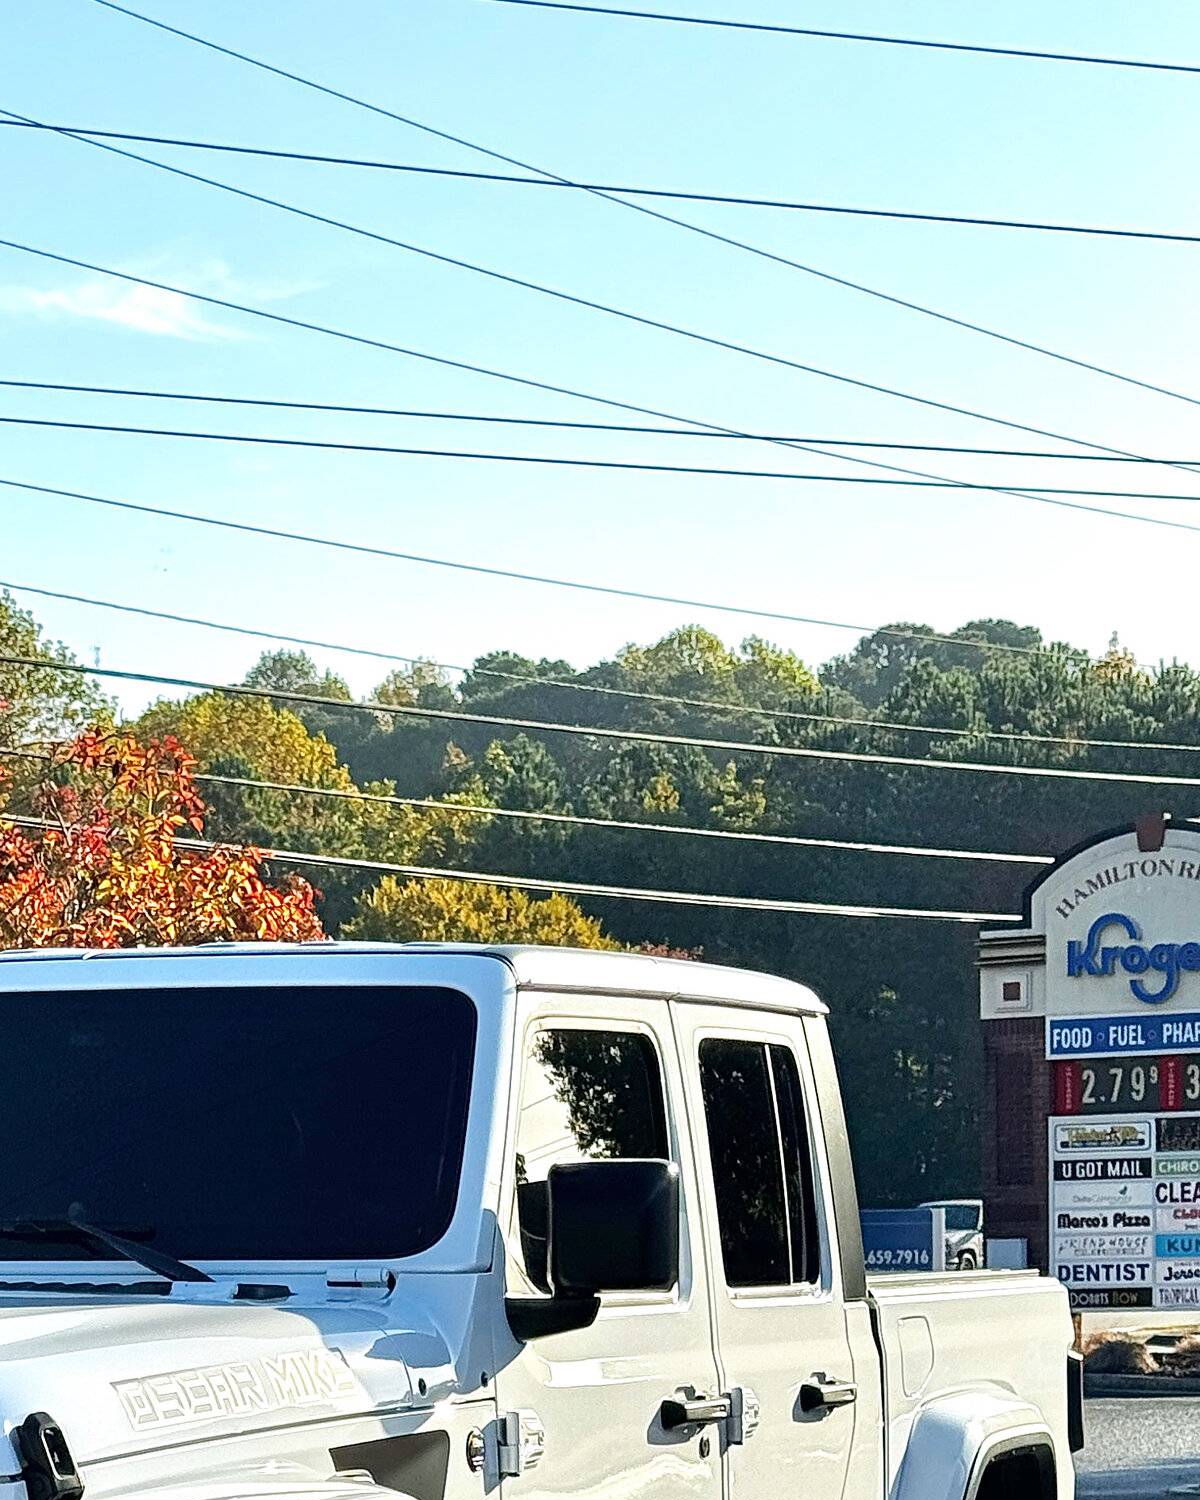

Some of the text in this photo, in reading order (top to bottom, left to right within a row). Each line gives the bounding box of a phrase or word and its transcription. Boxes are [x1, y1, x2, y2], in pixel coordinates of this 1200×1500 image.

[1056, 859, 1174, 919] HAMILTON
[1052, 1027, 1092, 1049] FOOD
[1108, 1024, 1146, 1047] FUEL
[1062, 1160, 1144, 1178] U GOT MAIL
[1159, 1160, 1200, 1175] CHIRO
[1057, 1211, 1151, 1229] Marco's Pizza
[1057, 1263, 1150, 1282] DENTIST
